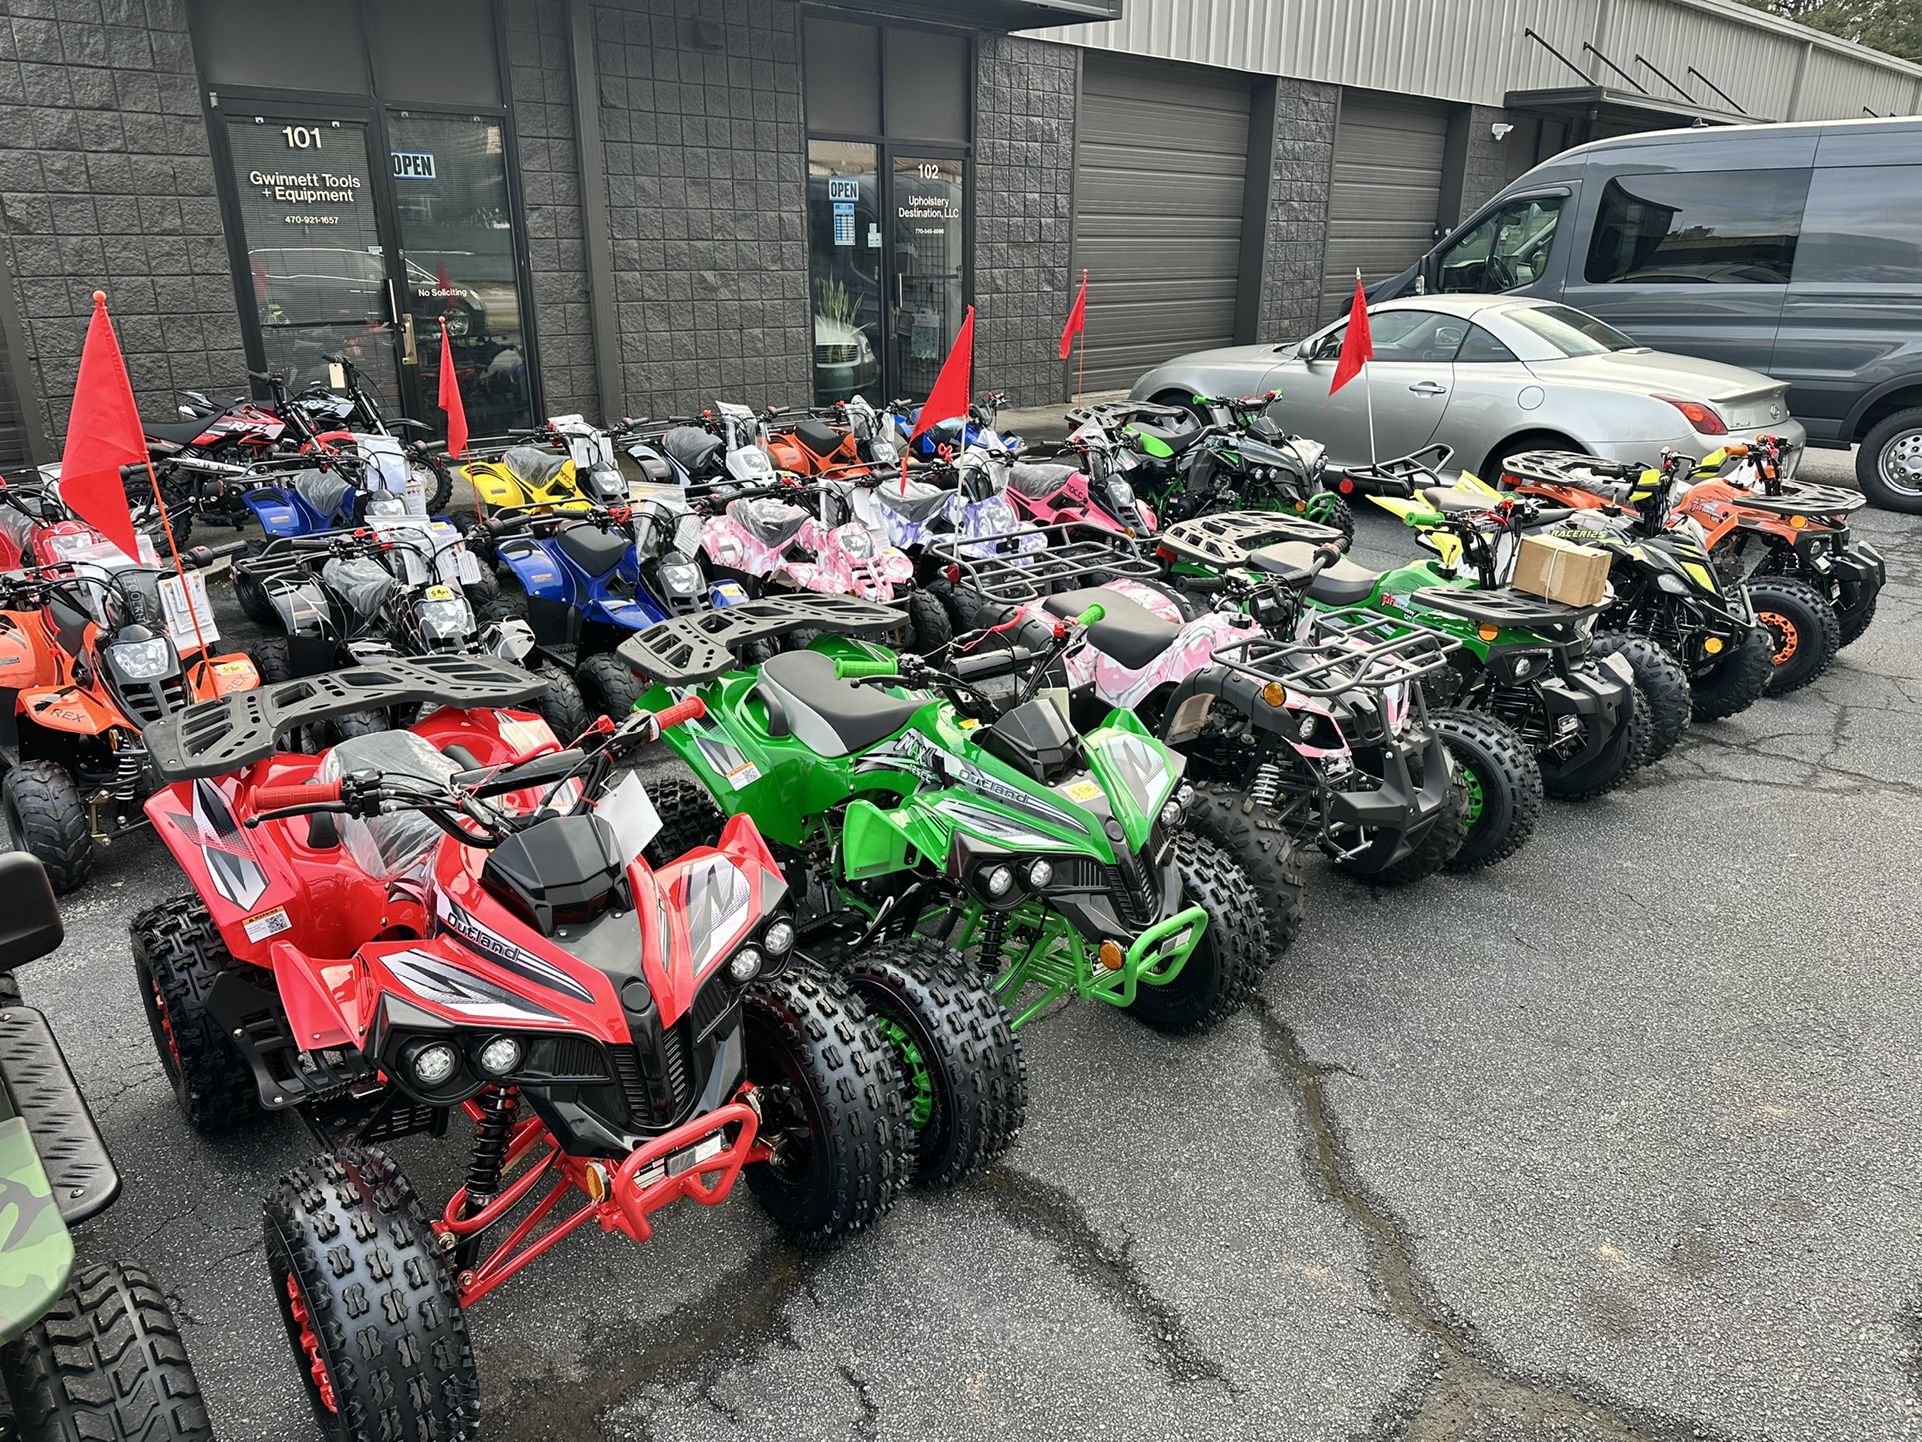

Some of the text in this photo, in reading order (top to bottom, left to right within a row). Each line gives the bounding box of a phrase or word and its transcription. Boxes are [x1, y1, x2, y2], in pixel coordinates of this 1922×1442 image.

[282, 126, 322, 149] 101
[394, 154, 432, 176] OPEN
[918, 164, 939, 179] 102
[250, 171, 361, 188] Gwinnett Tools
[262, 187, 354, 203] + Equipment
[831, 181, 858, 198] OPEN
[909, 196, 950, 208] Upholstery
[285, 215, 339, 225] 470-921-1657
[899, 208, 960, 219] Destination, LLC
[418, 288, 467, 298] No Soliciting
[1551, 530, 1609, 539] RACER125
[50, 708, 85, 722] REX
[959, 768, 1029, 804] Outland
[447, 911, 521, 962] Outland
